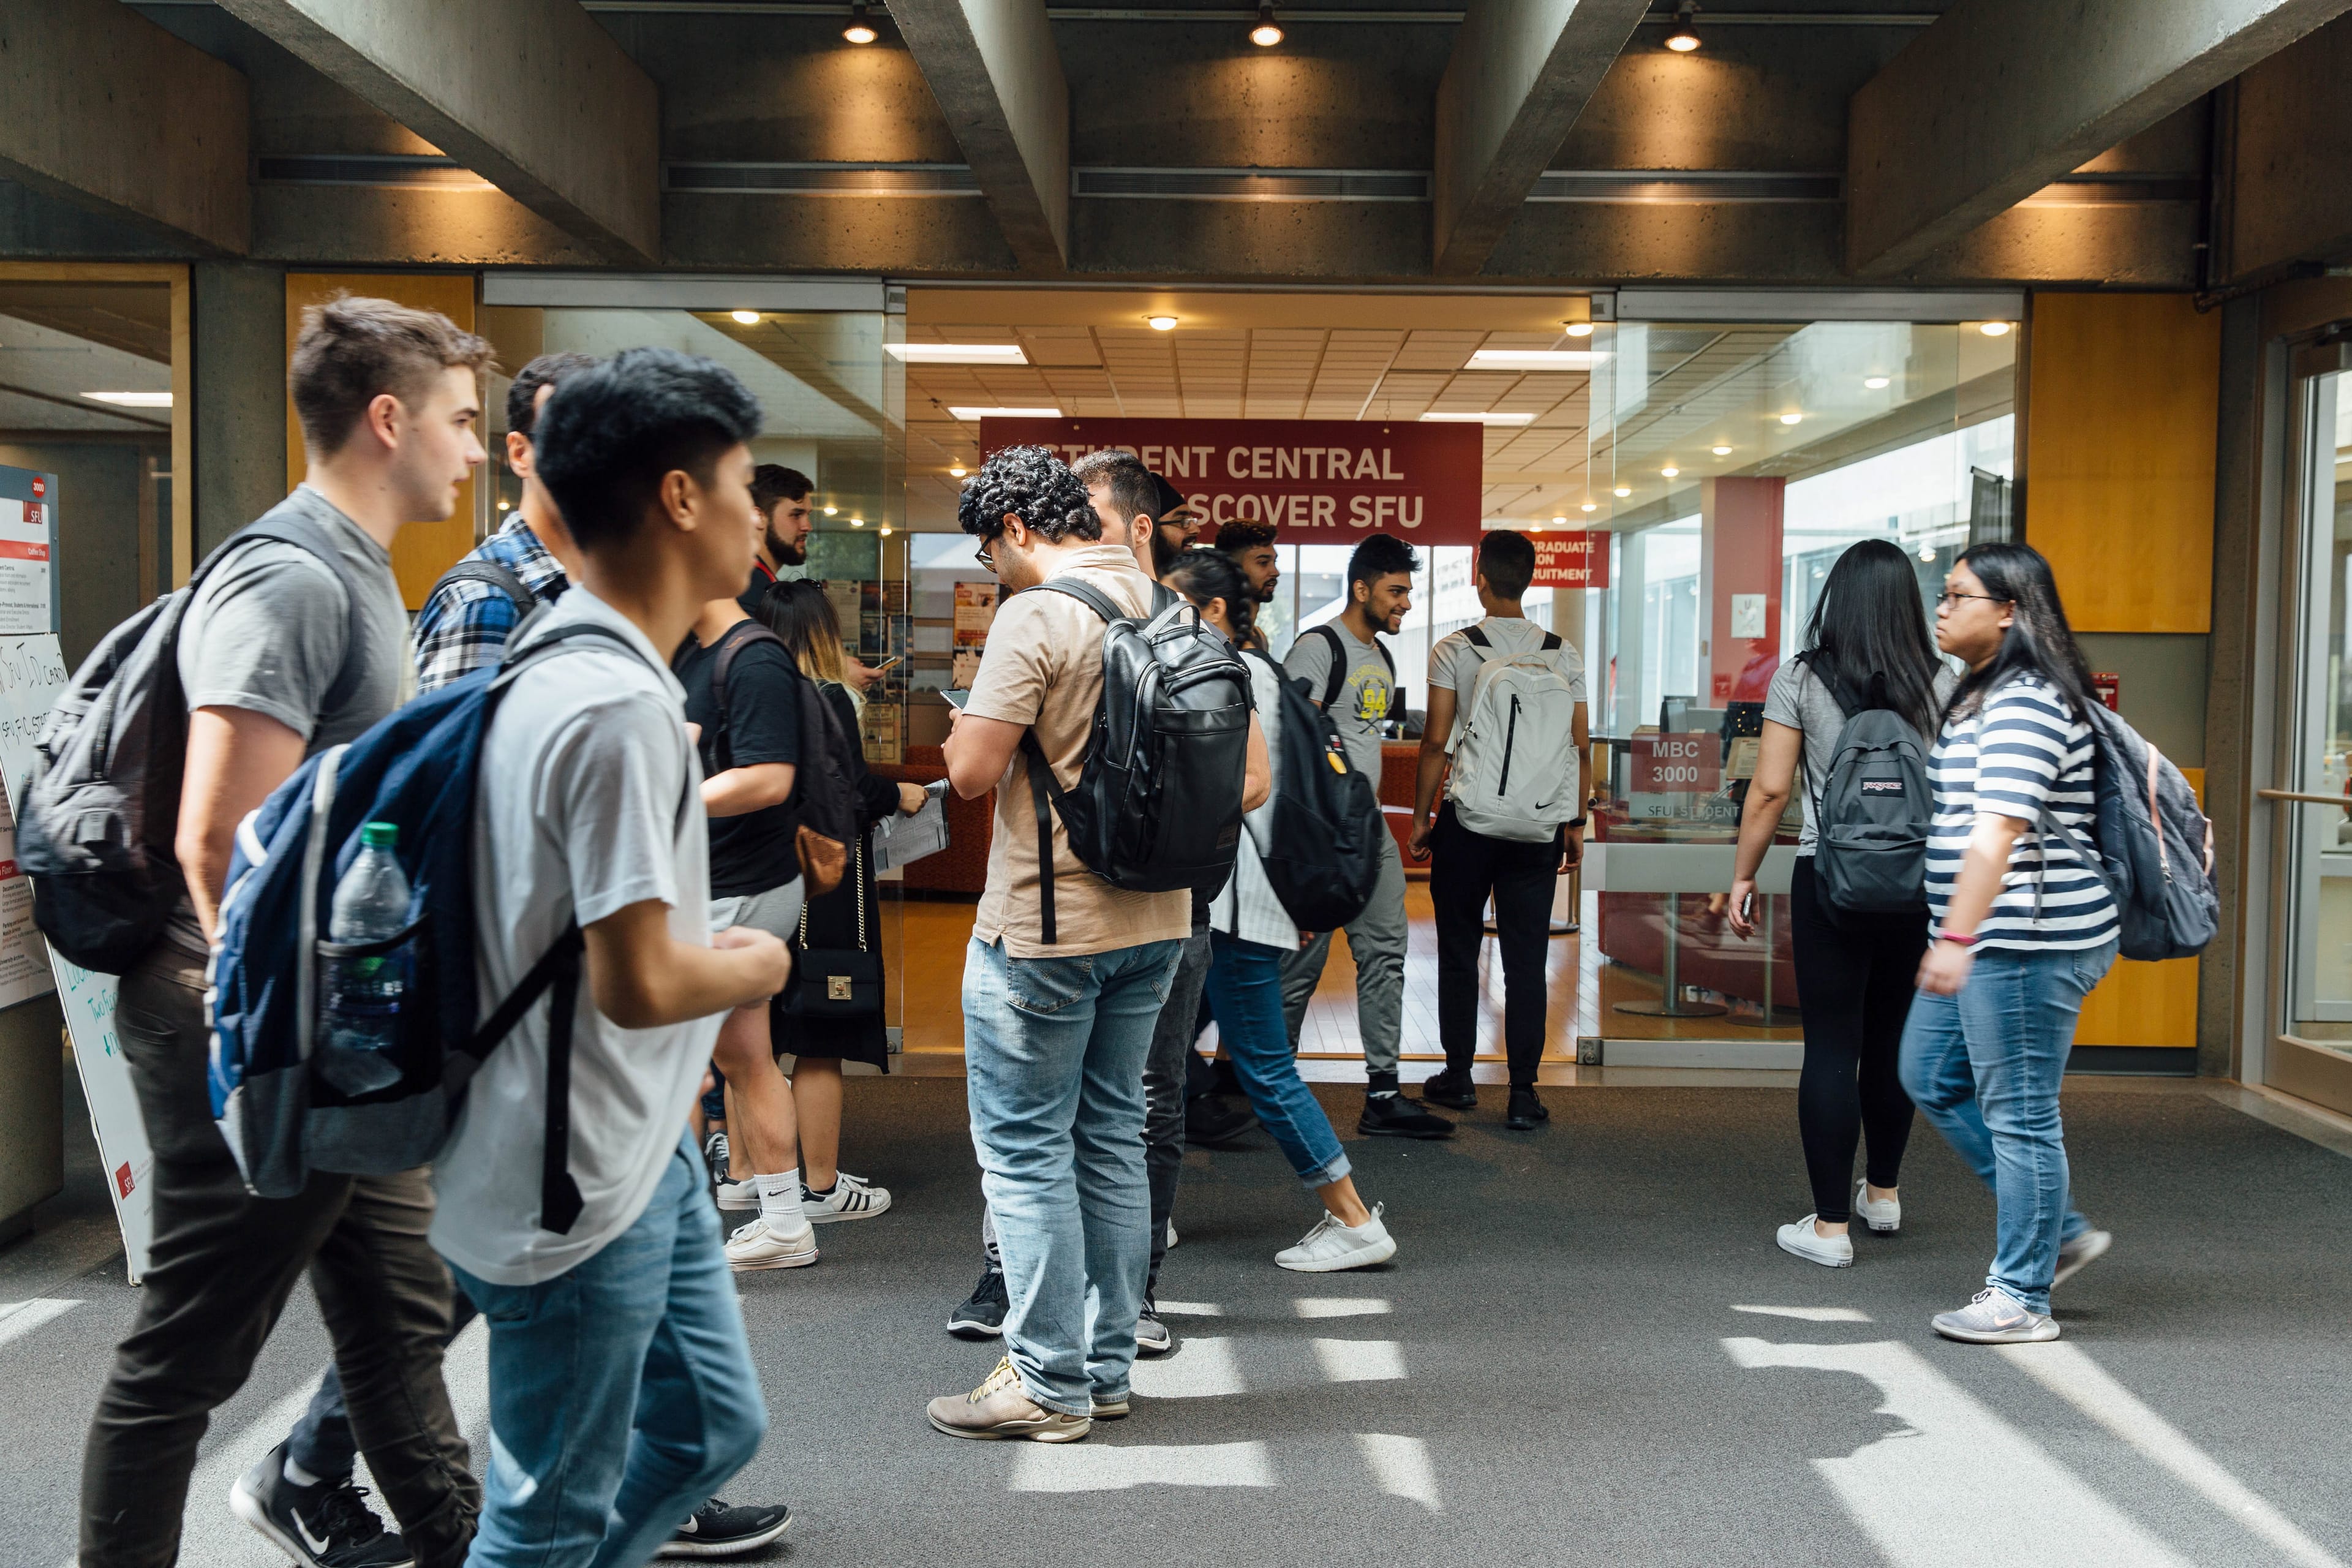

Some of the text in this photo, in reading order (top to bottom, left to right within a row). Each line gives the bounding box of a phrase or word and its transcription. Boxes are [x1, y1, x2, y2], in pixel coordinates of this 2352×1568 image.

[1227, 447, 1404, 481] CENTRAL
[34, 483, 44, 492] 3000
[31, 510, 42, 523] SFU
[1350, 495, 1423, 529] SFU
[17, 642, 42, 688] ID
[1360, 688, 1387, 719] 94
[1653, 741, 1698, 758] MBC
[1653, 766, 1698, 783] 3000
[1648, 805, 1672, 816] SFU
[124, 1174, 135, 1193] SFU
